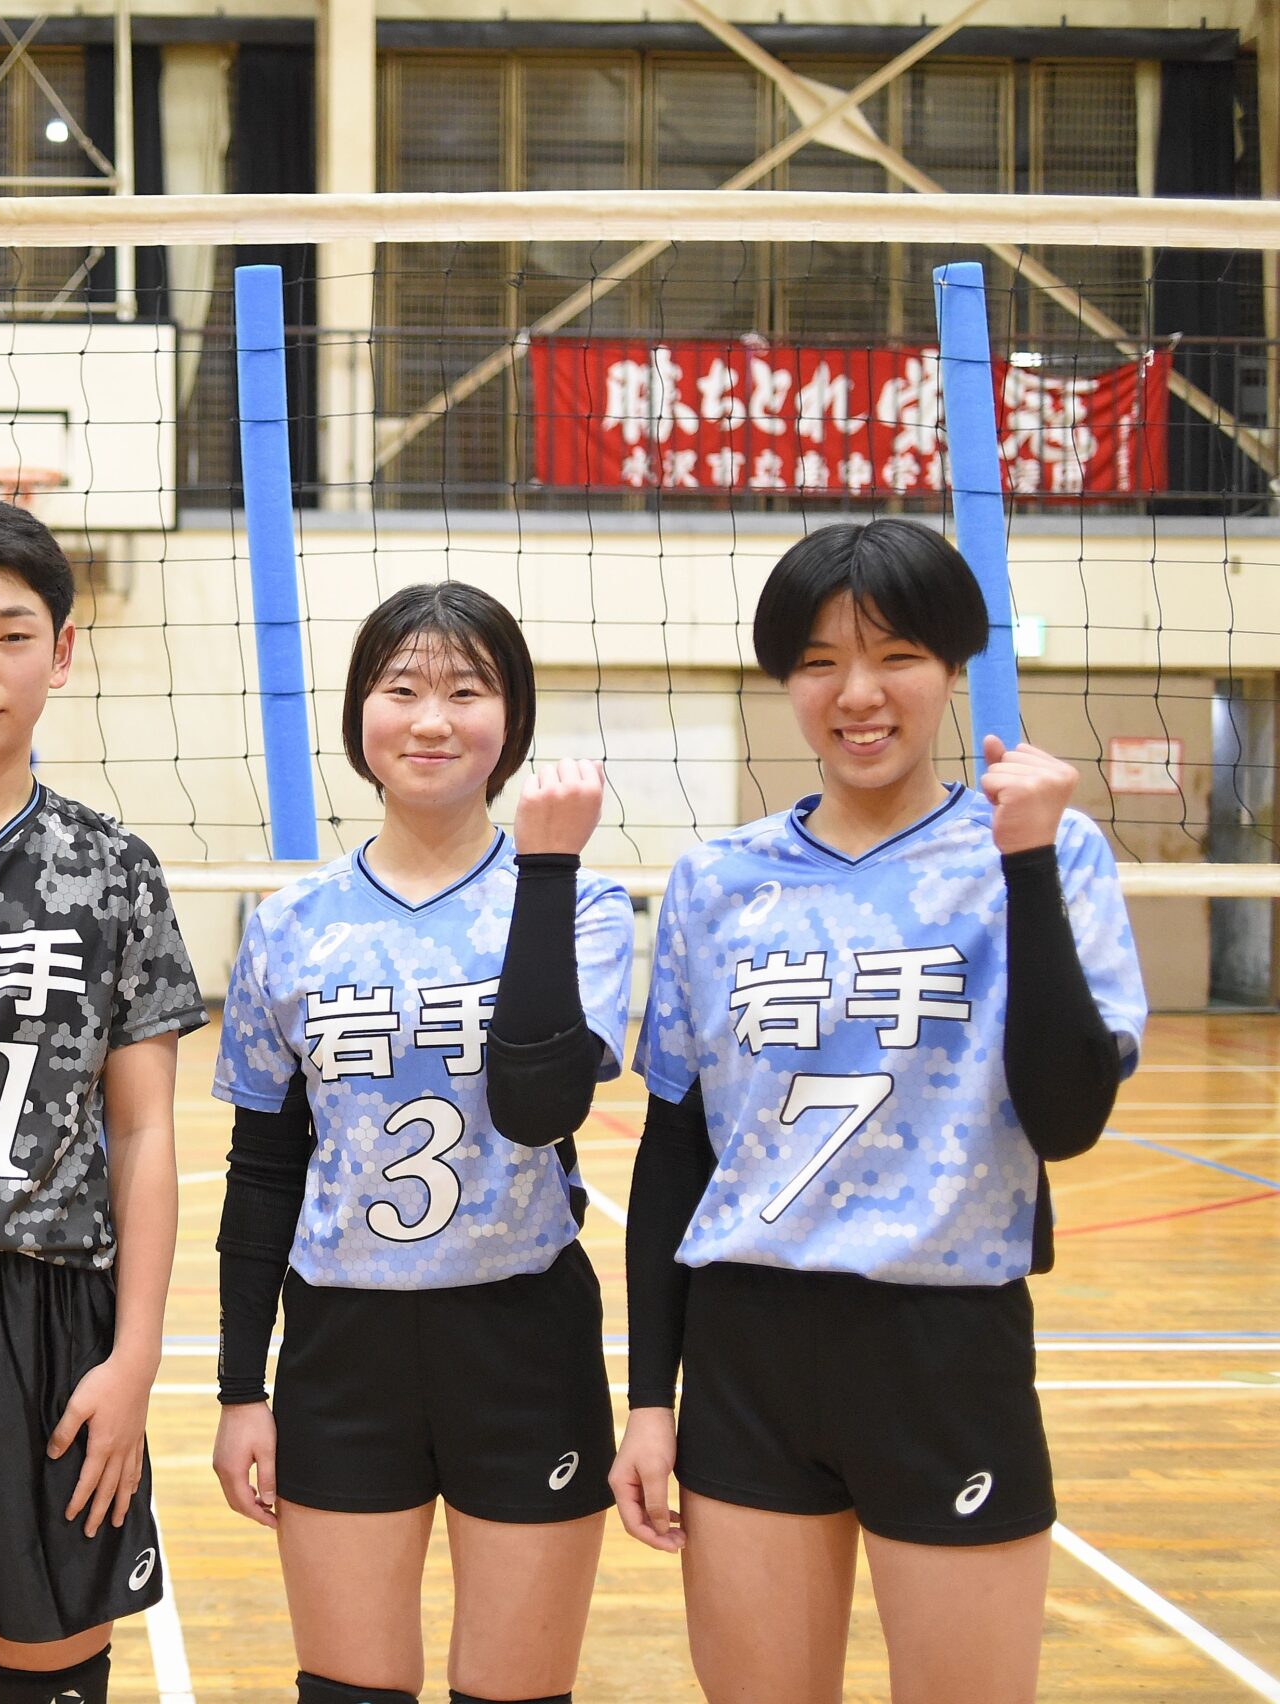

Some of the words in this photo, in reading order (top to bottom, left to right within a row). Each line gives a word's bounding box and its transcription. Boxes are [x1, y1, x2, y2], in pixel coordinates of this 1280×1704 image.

[303, 979, 499, 1083] 岩手
[729, 944, 973, 1056] 岩手
[365, 1095, 466, 1243] 3
[758, 1072, 895, 1226] 7
